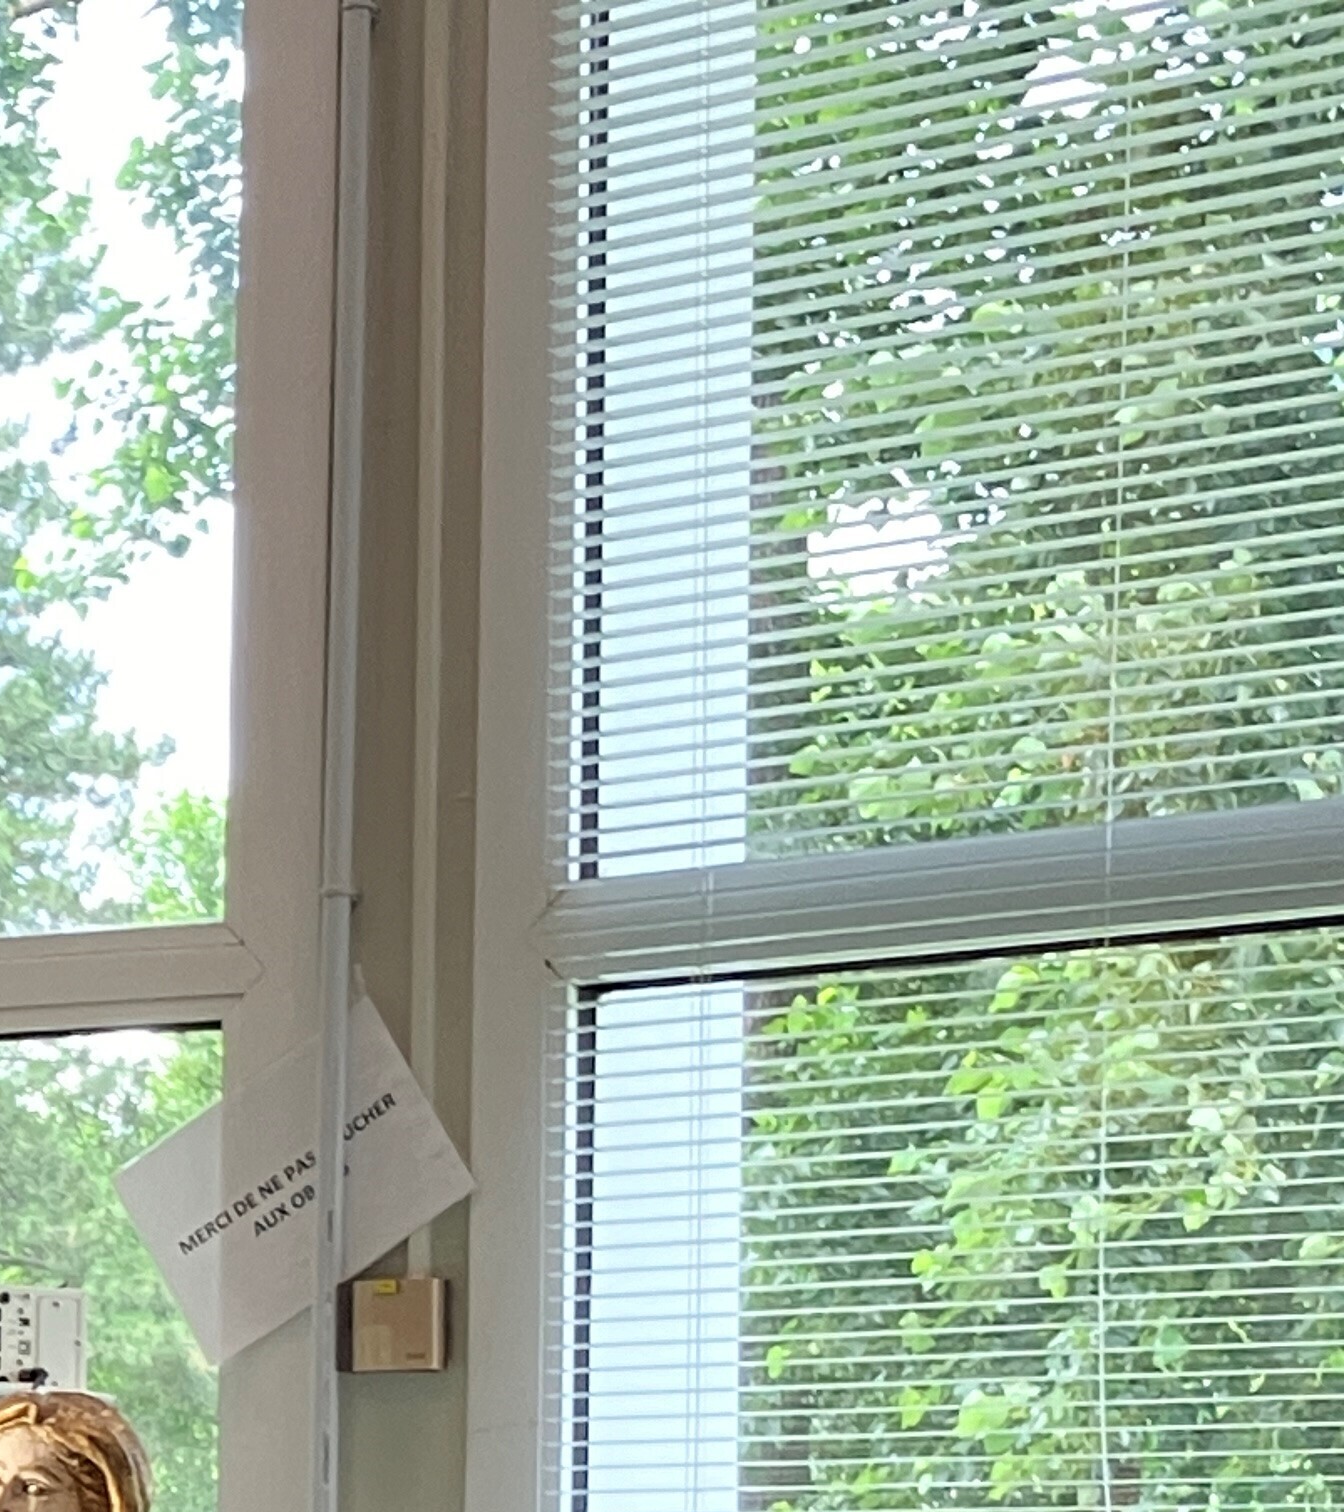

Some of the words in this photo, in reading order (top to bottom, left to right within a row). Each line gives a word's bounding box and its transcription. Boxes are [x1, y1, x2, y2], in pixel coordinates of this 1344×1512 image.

[178, 1210, 234, 1255] MERCI
[233, 1192, 259, 1218] DE
[257, 1174, 285, 1201] NE
[283, 1151, 317, 1182] PAS
[343, 1093, 397, 1141] UCHER
[253, 1202, 291, 1238] AUX
